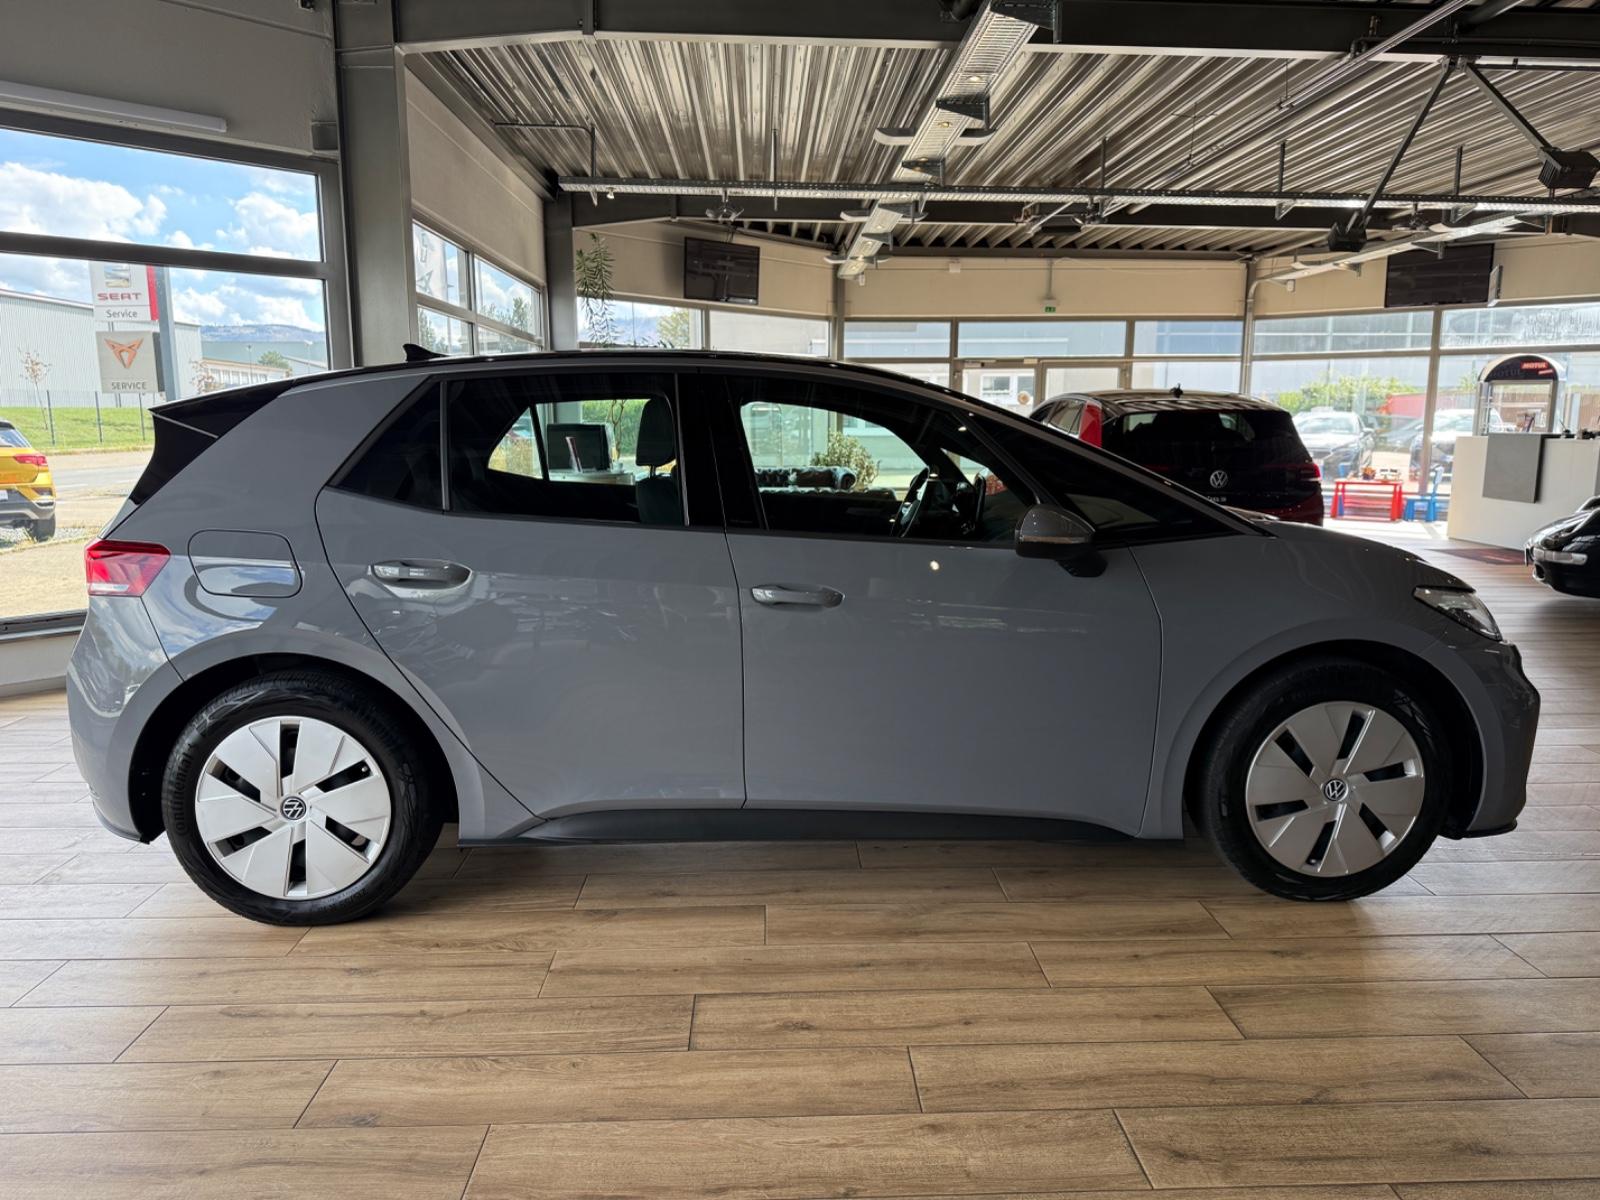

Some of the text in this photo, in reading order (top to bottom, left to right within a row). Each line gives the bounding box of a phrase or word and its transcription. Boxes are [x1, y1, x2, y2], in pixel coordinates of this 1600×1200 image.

[97, 292, 142, 301] SEAT
[106, 309, 138, 319] Service
[111, 381, 147, 390] SERVICE
